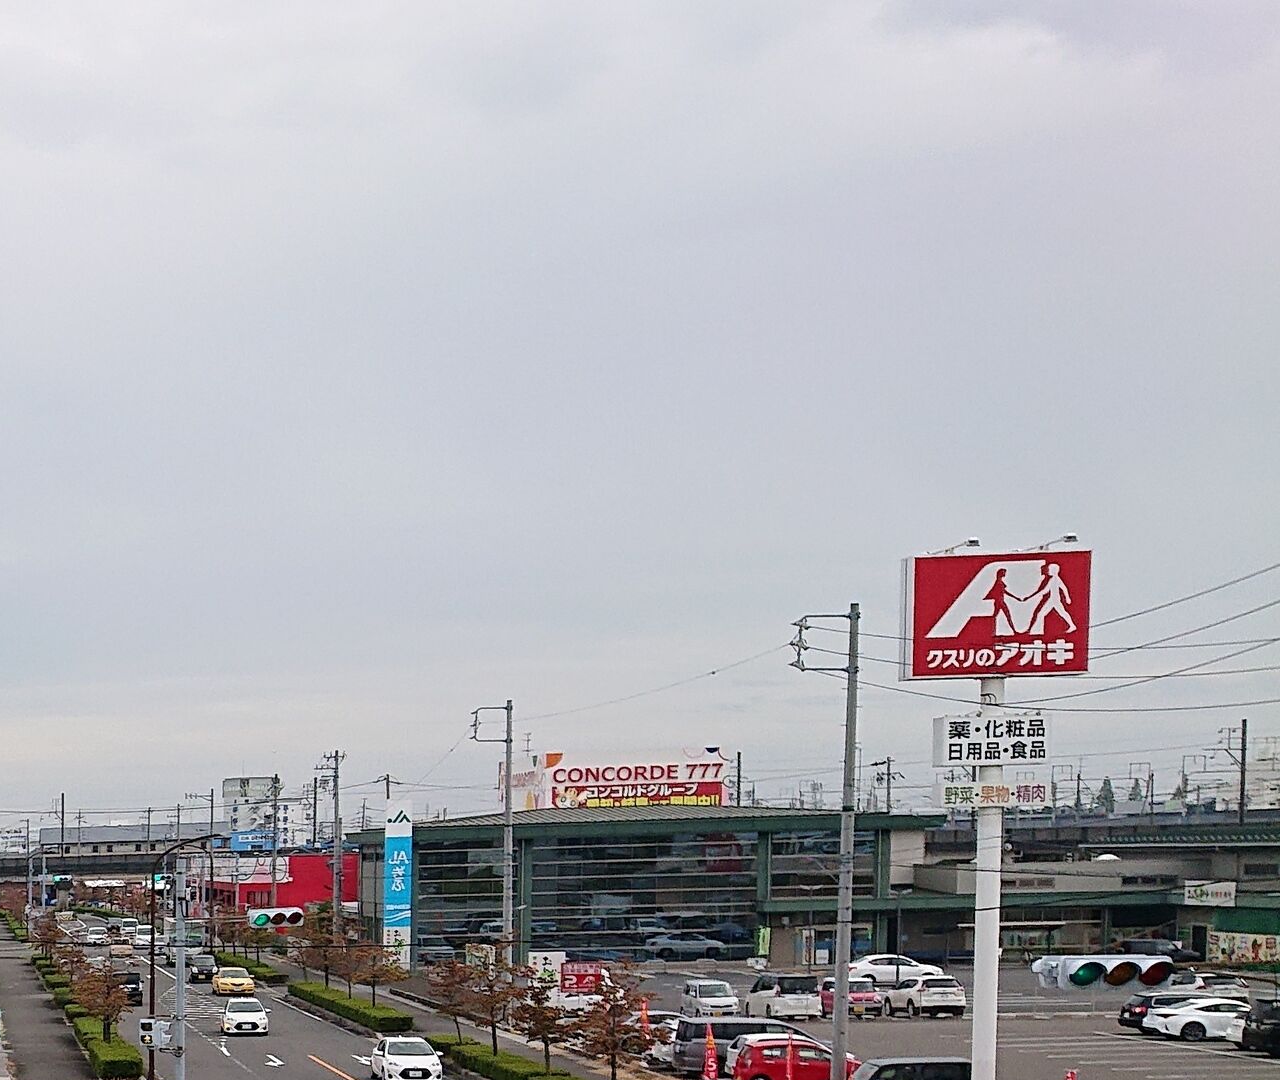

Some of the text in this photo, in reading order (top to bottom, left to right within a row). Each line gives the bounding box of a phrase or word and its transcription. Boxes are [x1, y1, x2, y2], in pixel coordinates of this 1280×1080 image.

[926, 639, 1075, 669] クスリのアオキ
[948, 719, 1045, 739] 薬・化粧品
[948, 741, 1046, 760] 日用品・食品
[553, 765, 679, 784] CONCORDE
[686, 763, 724, 780] 777
[586, 782, 699, 799] コンコルドグループ
[944, 784, 1046, 805] 野菜・果物・精肉
